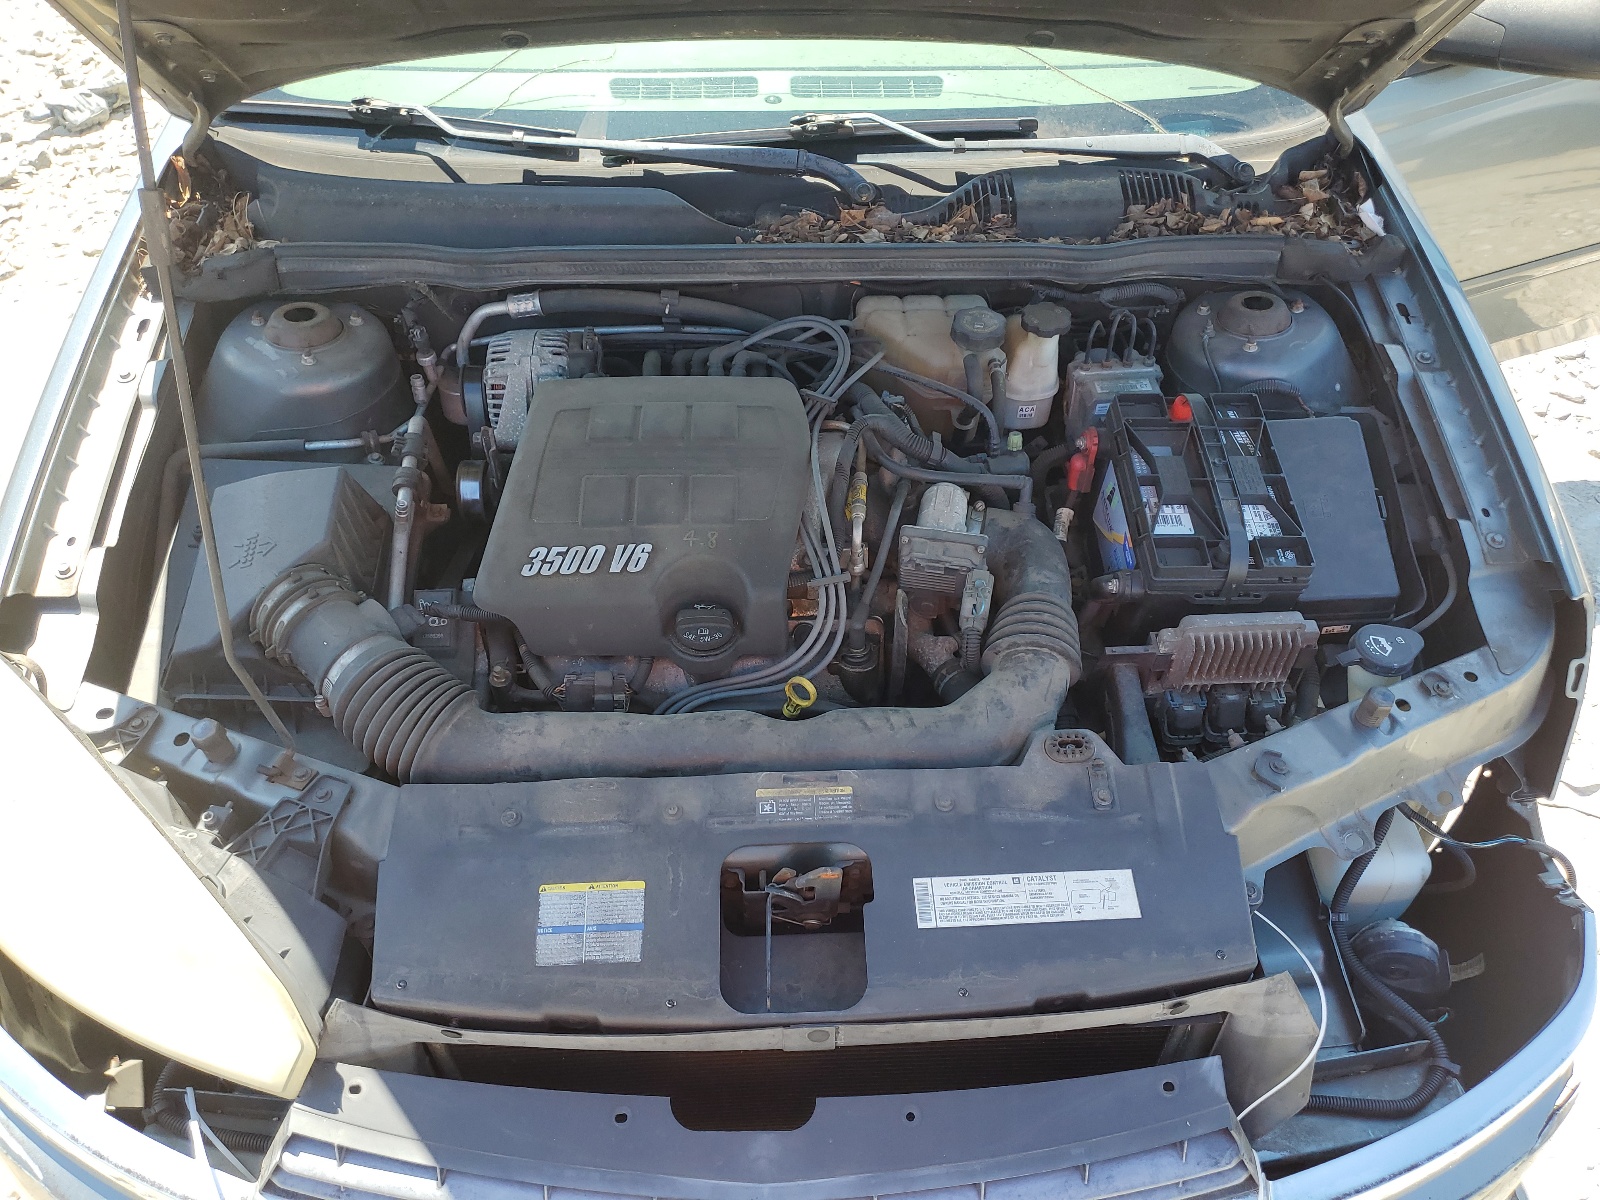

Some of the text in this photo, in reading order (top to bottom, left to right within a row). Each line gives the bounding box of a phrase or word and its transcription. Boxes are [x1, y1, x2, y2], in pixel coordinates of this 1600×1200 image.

[521, 542, 653, 578] 3500 V6
[683, 631, 723, 643] SAE 5W-30
[1026, 874, 1058, 882] CATALYST
